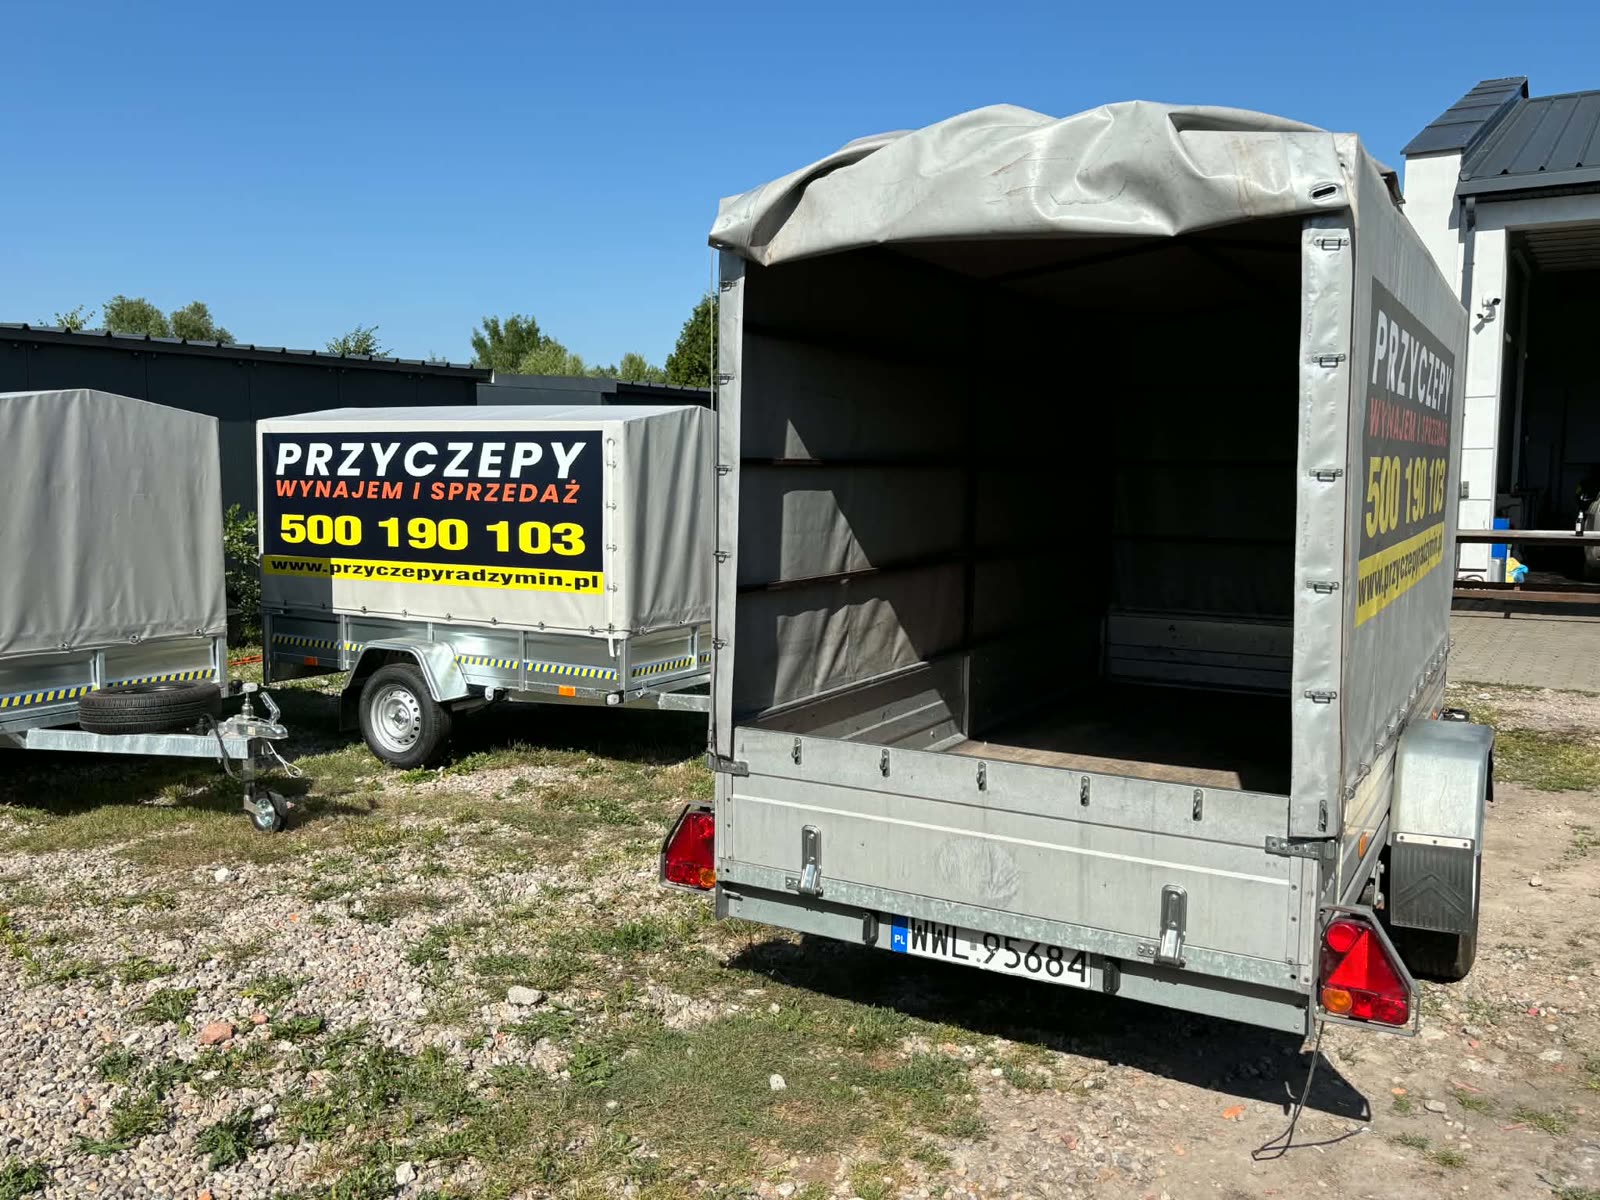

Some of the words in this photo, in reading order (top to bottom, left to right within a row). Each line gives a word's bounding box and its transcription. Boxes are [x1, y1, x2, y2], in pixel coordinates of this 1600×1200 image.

[1372, 309, 1452, 415] PRZYCZEPY
[1369, 397, 1416, 442] WYNAJEM
[275, 441, 587, 479] PRZYCZEPY
[275, 479, 404, 500] WYNAJEM
[412, 482, 421, 500] I
[430, 479, 581, 504] SPRZEDAŻ
[1365, 455, 1400, 539] 500
[1405, 456, 1427, 525] 190
[1429, 458, 1446, 515] 103
[280, 513, 362, 546] 500
[378, 517, 469, 551] 190
[485, 520, 586, 557] 103
[271, 560, 598, 591] www.przyczepyradzymin.pl
[894, 935, 906, 946] PL
[910, 917, 969, 961] WWL
[982, 932, 1087, 983] 95684
